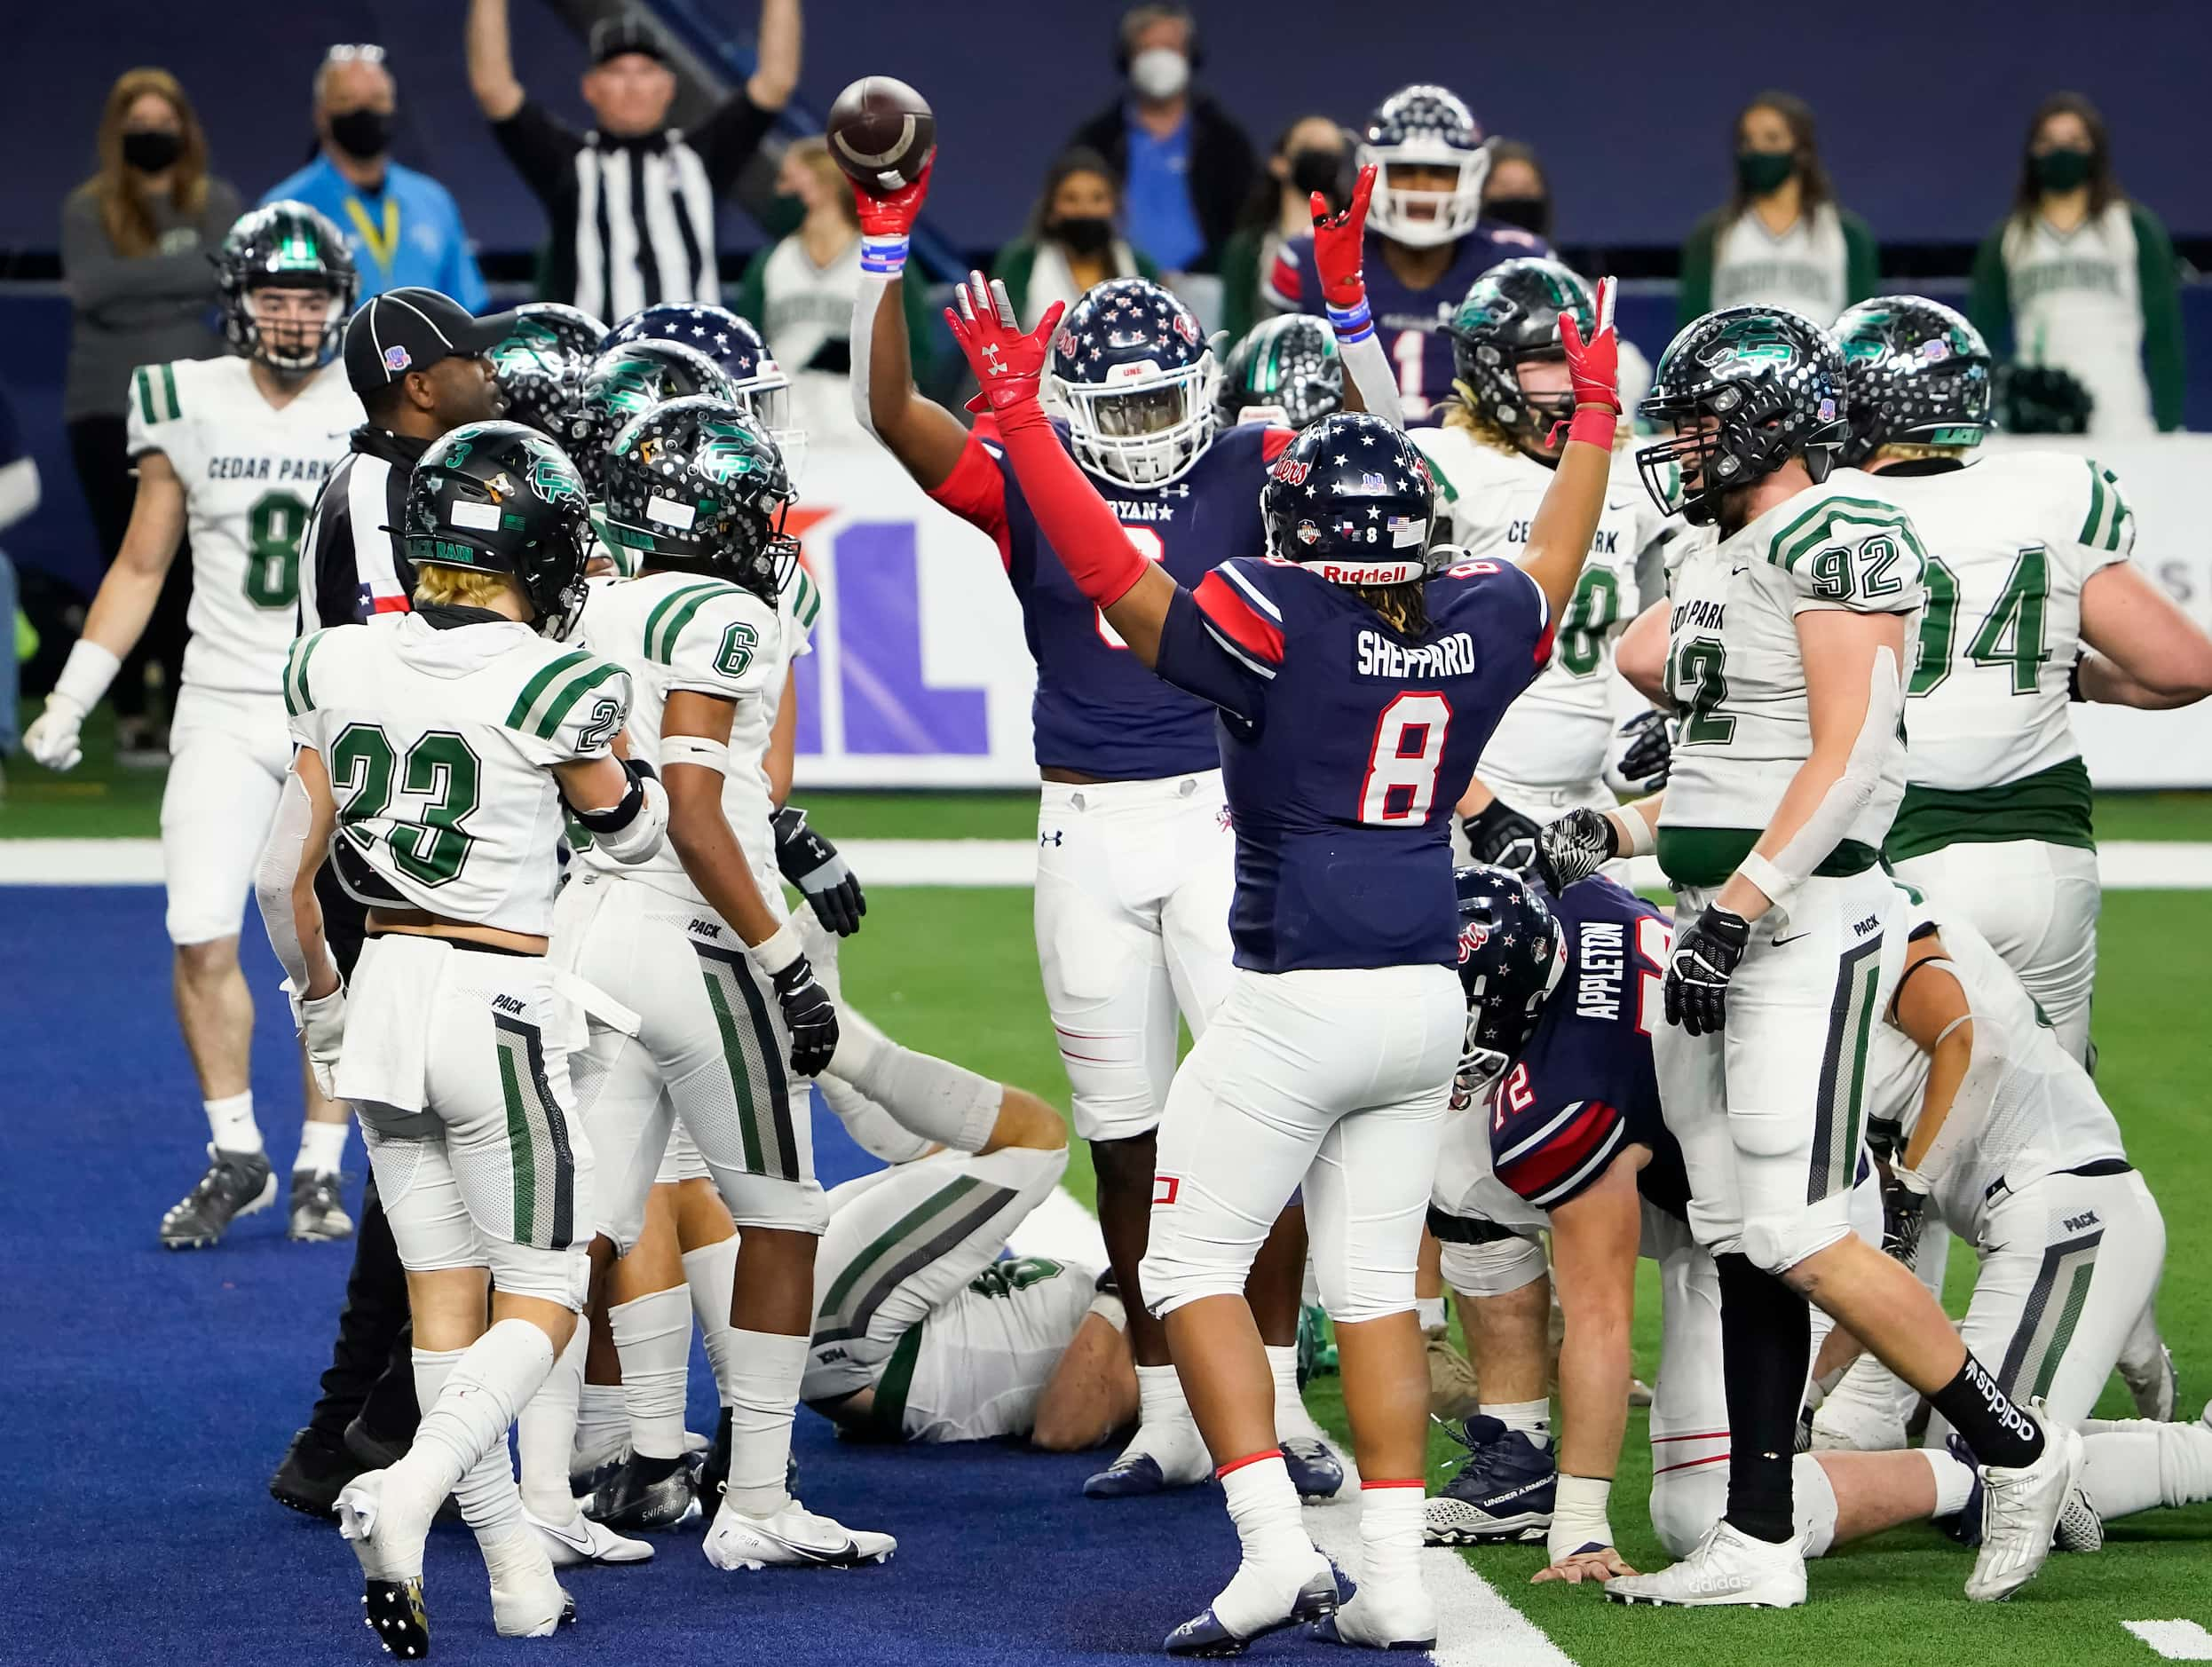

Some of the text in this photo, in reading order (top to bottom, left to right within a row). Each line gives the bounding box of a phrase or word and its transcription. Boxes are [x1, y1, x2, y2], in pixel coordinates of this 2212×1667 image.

[208, 457, 271, 479] CEDAR
[1366, 527, 1378, 543] 8
[242, 489, 312, 612] 8
[436, 541, 474, 564] RAIN
[1323, 565, 1407, 584] Riddell
[1811, 534, 1902, 602] 92
[1687, 600, 1726, 629] PARK
[713, 621, 759, 679] 6
[1357, 630, 1475, 678] SHEPPARD
[1357, 691, 1454, 826] 8
[331, 723, 482, 889] 23
[687, 919, 723, 939] PACK
[1853, 913, 1881, 938] PACK
[1576, 922, 1623, 1021] APPLETON
[492, 993, 526, 1016] PACK
[2062, 1209, 2101, 1233] PACK
[1976, 1370, 2034, 1442] adidas
[1483, 1491, 1518, 1507] UNDER
[1688, 1575, 1752, 1594] adidas
